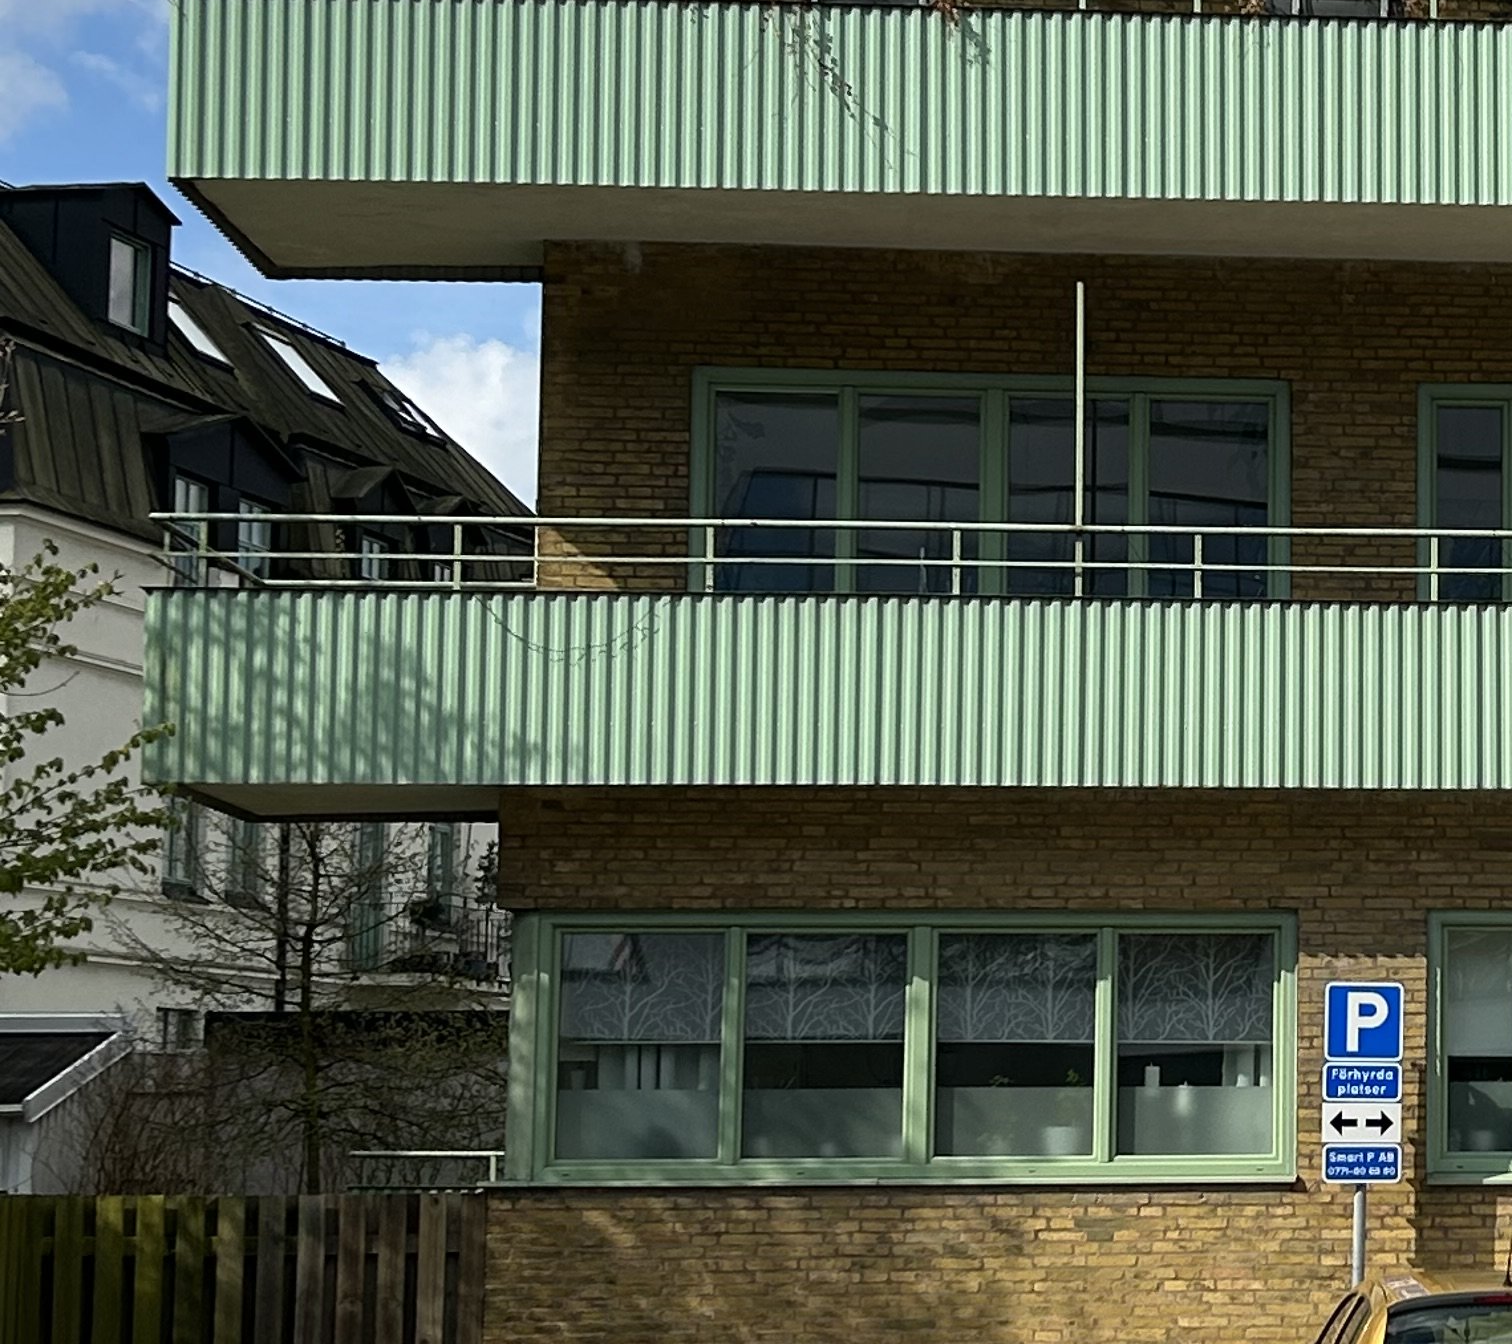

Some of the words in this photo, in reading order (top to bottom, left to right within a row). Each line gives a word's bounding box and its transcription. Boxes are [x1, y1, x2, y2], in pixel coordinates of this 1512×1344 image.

[1346, 992, 1389, 1052] P
[1331, 1068, 1394, 1082] Förhyrda
[1337, 1083, 1387, 1096] platser
[1329, 1152, 1364, 1163] Smart
[1366, 1152, 1375, 1163] P
[1378, 1152, 1395, 1163] AB
